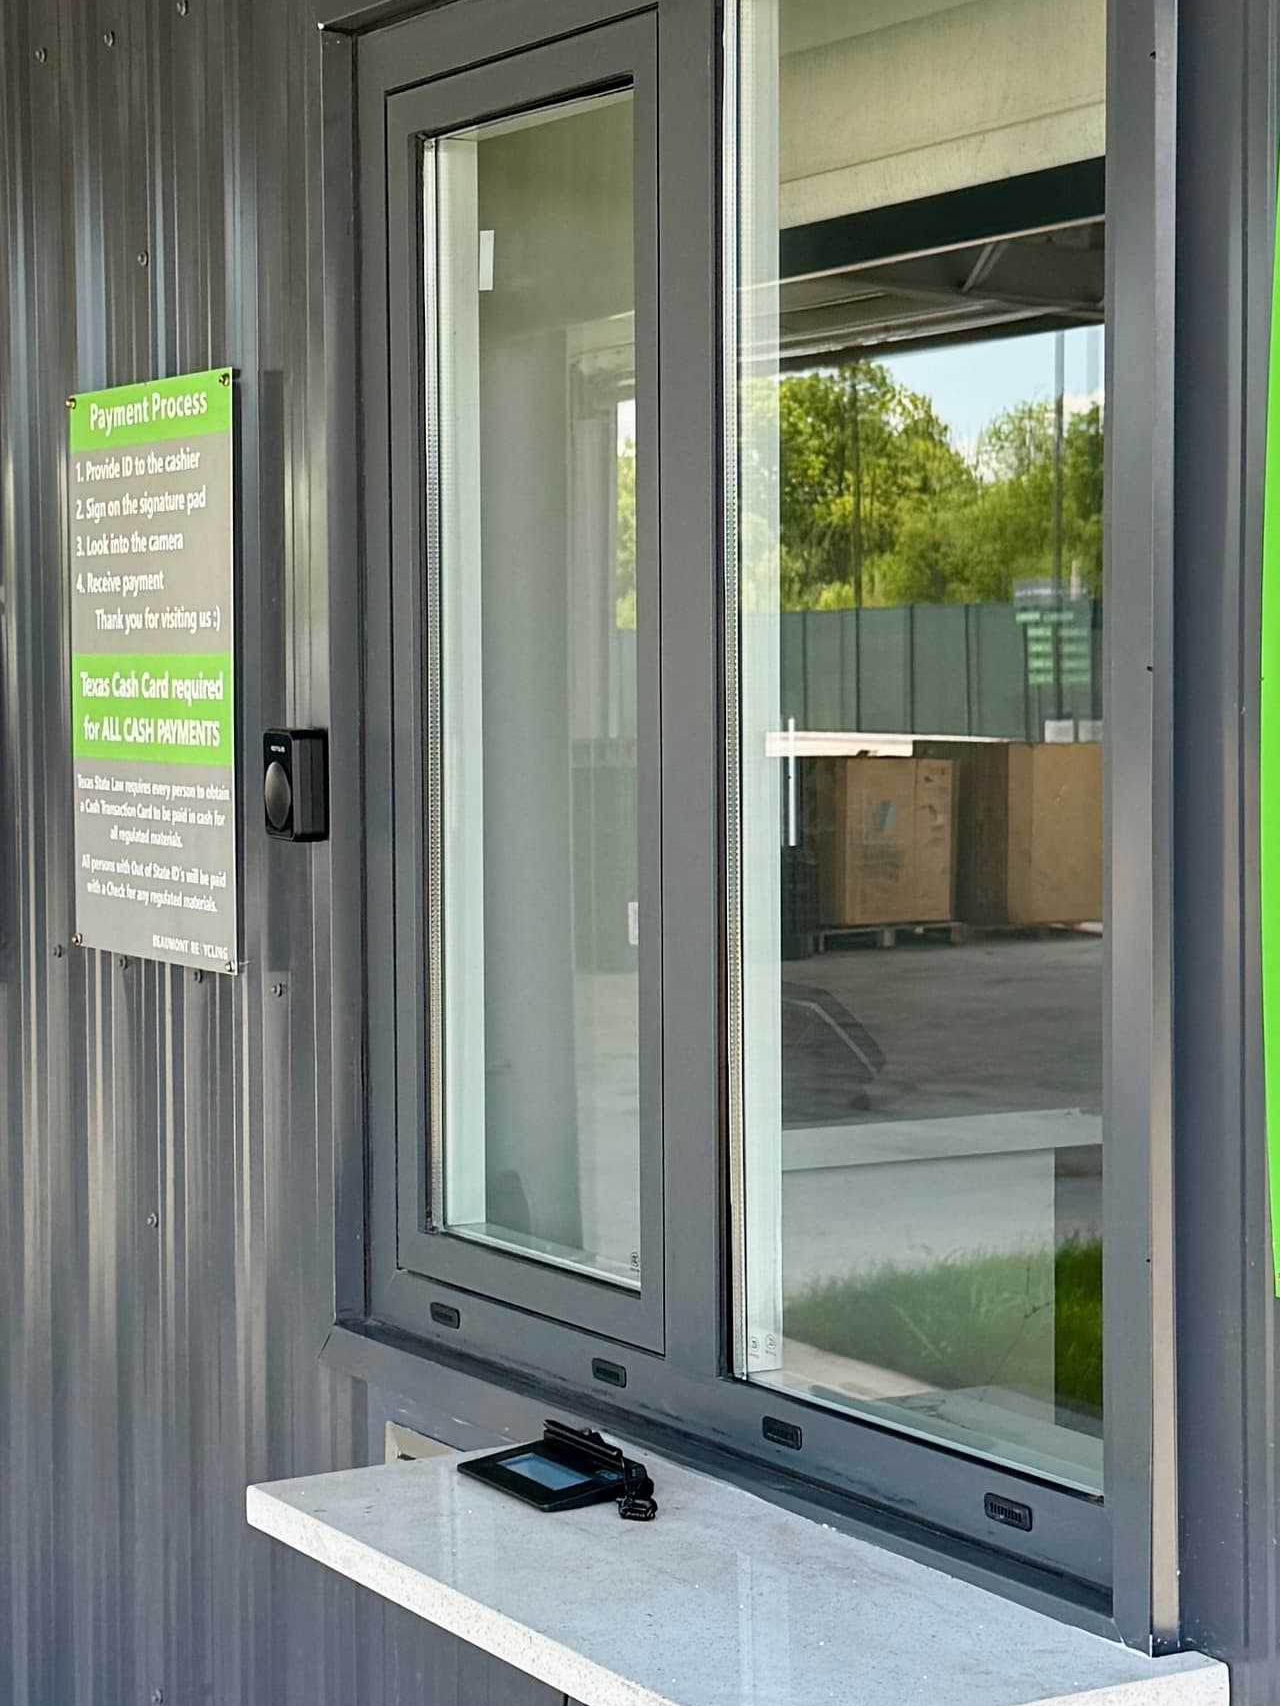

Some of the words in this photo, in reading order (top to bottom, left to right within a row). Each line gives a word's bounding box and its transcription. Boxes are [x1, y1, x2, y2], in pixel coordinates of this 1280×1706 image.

[90, 397, 149, 435] Payment
[152, 392, 208, 420] Process
[76, 462, 84, 482] 1.
[86, 457, 120, 481] Provide
[122, 456, 133, 477] ID
[135, 457, 145, 475] to
[147, 452, 163, 473] the
[165, 447, 200, 471] cashier
[76, 500, 84, 519] 2.
[86, 498, 106, 523] Sign
[108, 501, 120, 516] on
[122, 493, 138, 515] the
[139, 492, 185, 518] signature
[187, 485, 206, 515] pad
[76, 536, 85, 556] 3.
[86, 534, 109, 556] Look
[111, 534, 129, 553] into
[131, 531, 147, 552] the
[149, 534, 184, 551] camera
[76, 574, 85, 592] 4.
[87, 571, 121, 592] Receive
[122, 571, 164, 597] payment
[95, 608, 123, 629] Thank
[125, 614, 143, 634] you
[145, 607, 159, 628] for
[161, 606, 197, 633] visiting
[199, 612, 211, 627] us
[80, 672, 109, 697] Texas
[112, 671, 139, 697] Cash
[141, 672, 169, 698] Card
[171, 672, 224, 706] required
[84, 715, 101, 740] for
[102, 717, 122, 741] ALL
[123, 718, 154, 743] CASH
[158, 719, 220, 746] PAYMENTS
